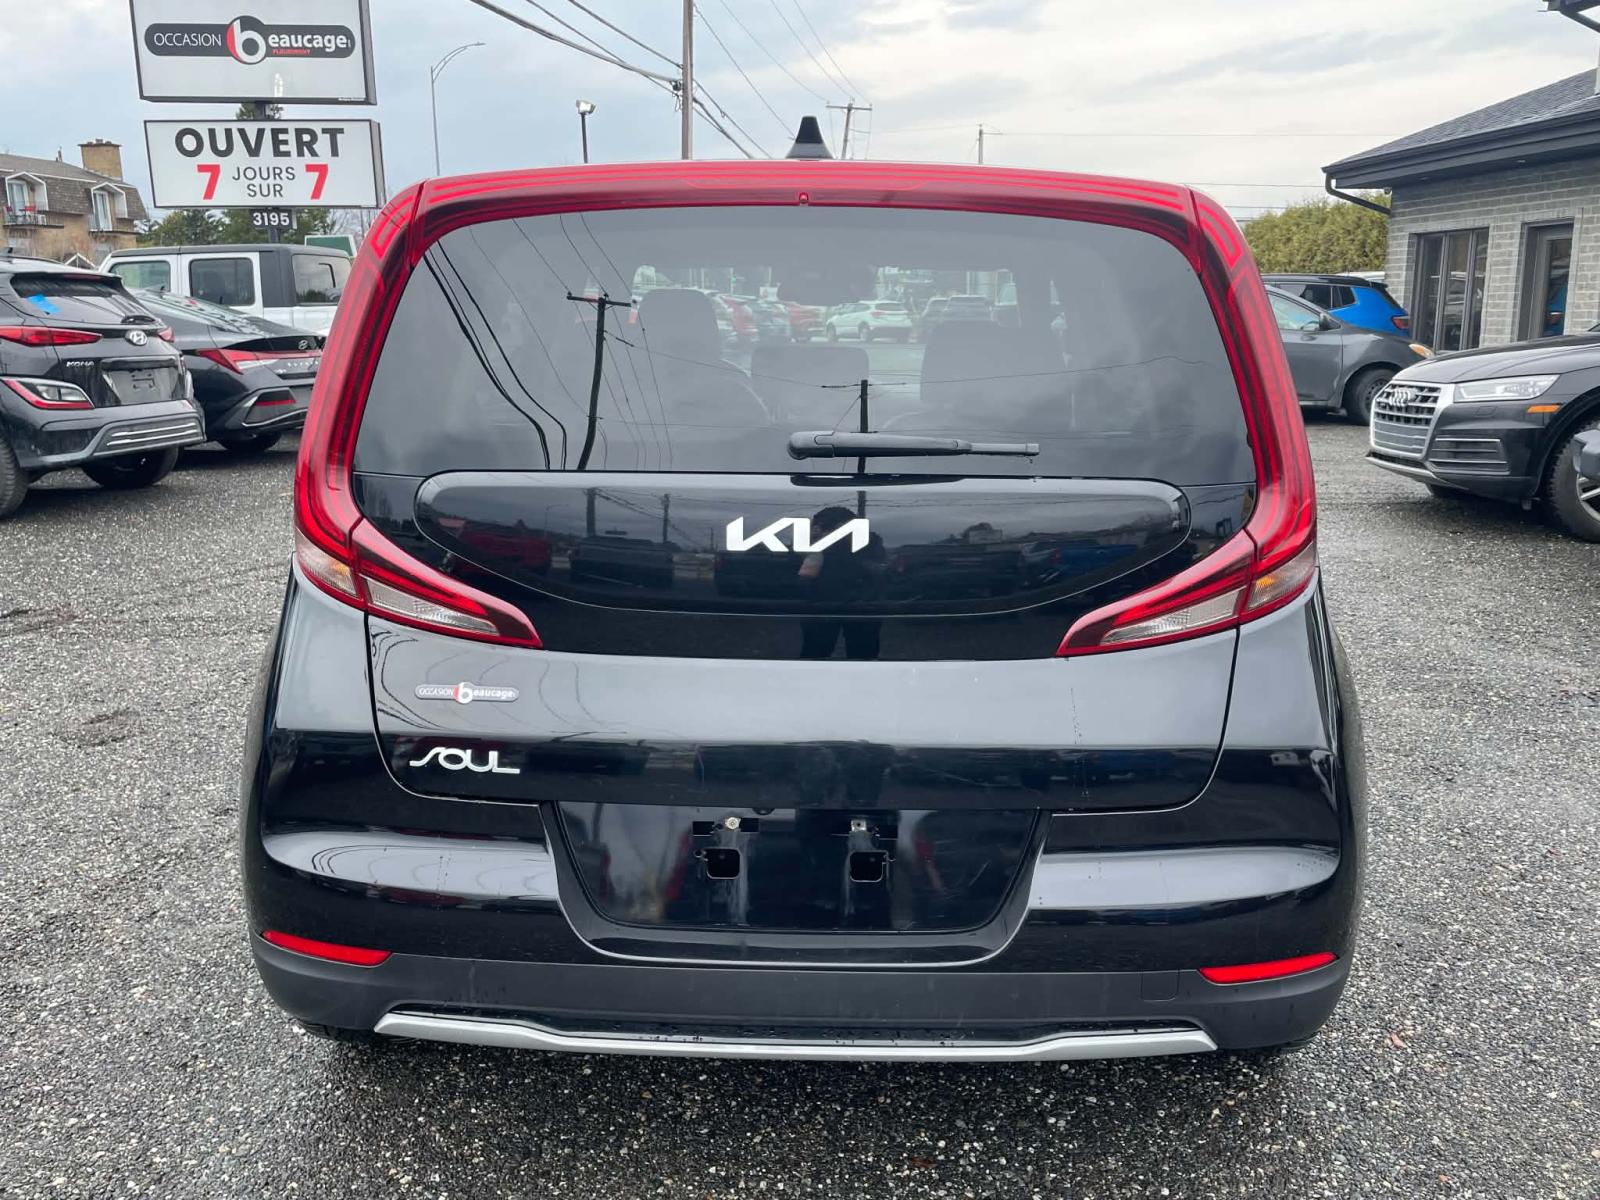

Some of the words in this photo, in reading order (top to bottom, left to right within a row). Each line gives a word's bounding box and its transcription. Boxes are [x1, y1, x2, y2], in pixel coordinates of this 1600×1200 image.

[153, 33, 222, 47] OCCASION
[174, 127, 344, 158] OUVERT
[197, 163, 221, 200] 7
[232, 166, 295, 181] JOURS
[305, 163, 329, 200] 7
[246, 183, 284, 198] SUR
[253, 212, 290, 226] 3195
[726, 516, 870, 553] KIA
[419, 687, 454, 697] OCCASION
[409, 746, 521, 775] SOUL
